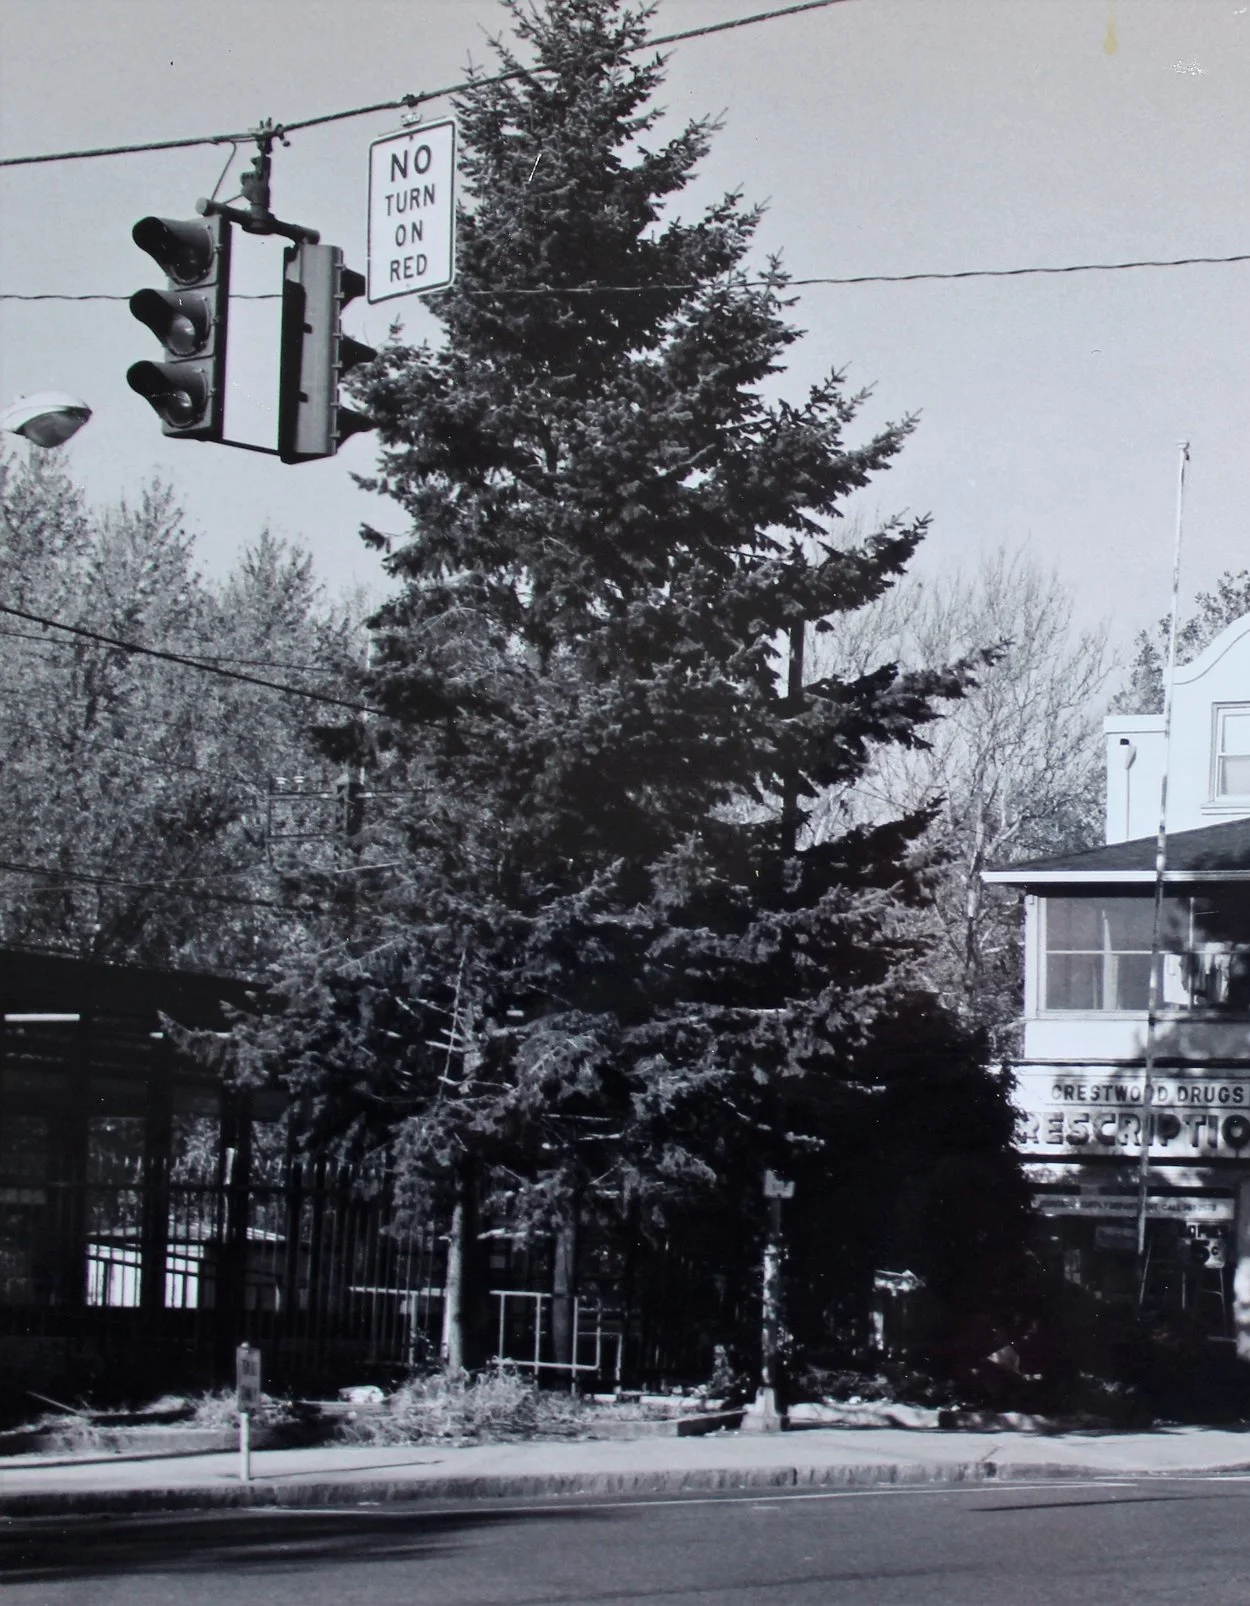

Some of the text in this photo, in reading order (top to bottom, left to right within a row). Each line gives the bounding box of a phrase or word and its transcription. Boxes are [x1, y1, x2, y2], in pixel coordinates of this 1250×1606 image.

[390, 144, 432, 183] NO
[385, 183, 436, 217] TURN
[395, 219, 423, 248] ON
[389, 253, 428, 283] RED
[1177, 1085, 1245, 1105] DRUGS
